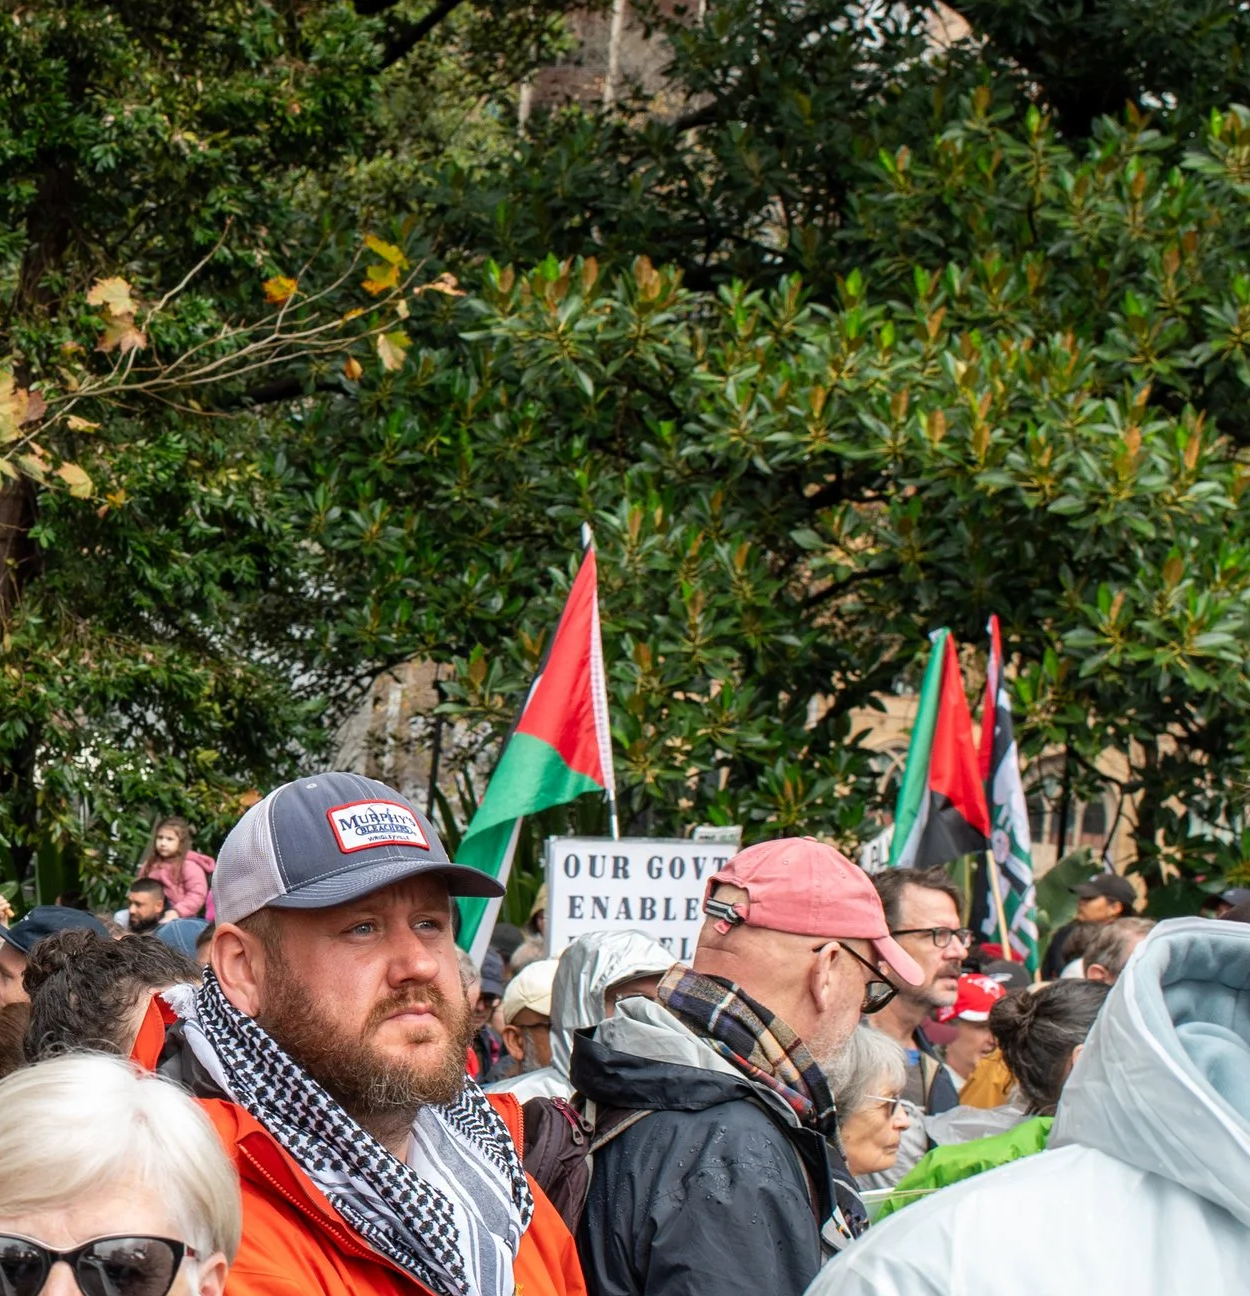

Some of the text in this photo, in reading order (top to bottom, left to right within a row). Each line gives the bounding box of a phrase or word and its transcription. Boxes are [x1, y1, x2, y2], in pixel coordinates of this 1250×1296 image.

[338, 812, 416, 832] MURPHY'S
[563, 853, 728, 880] OUR GOVT
[567, 895, 699, 921] ENABLE
